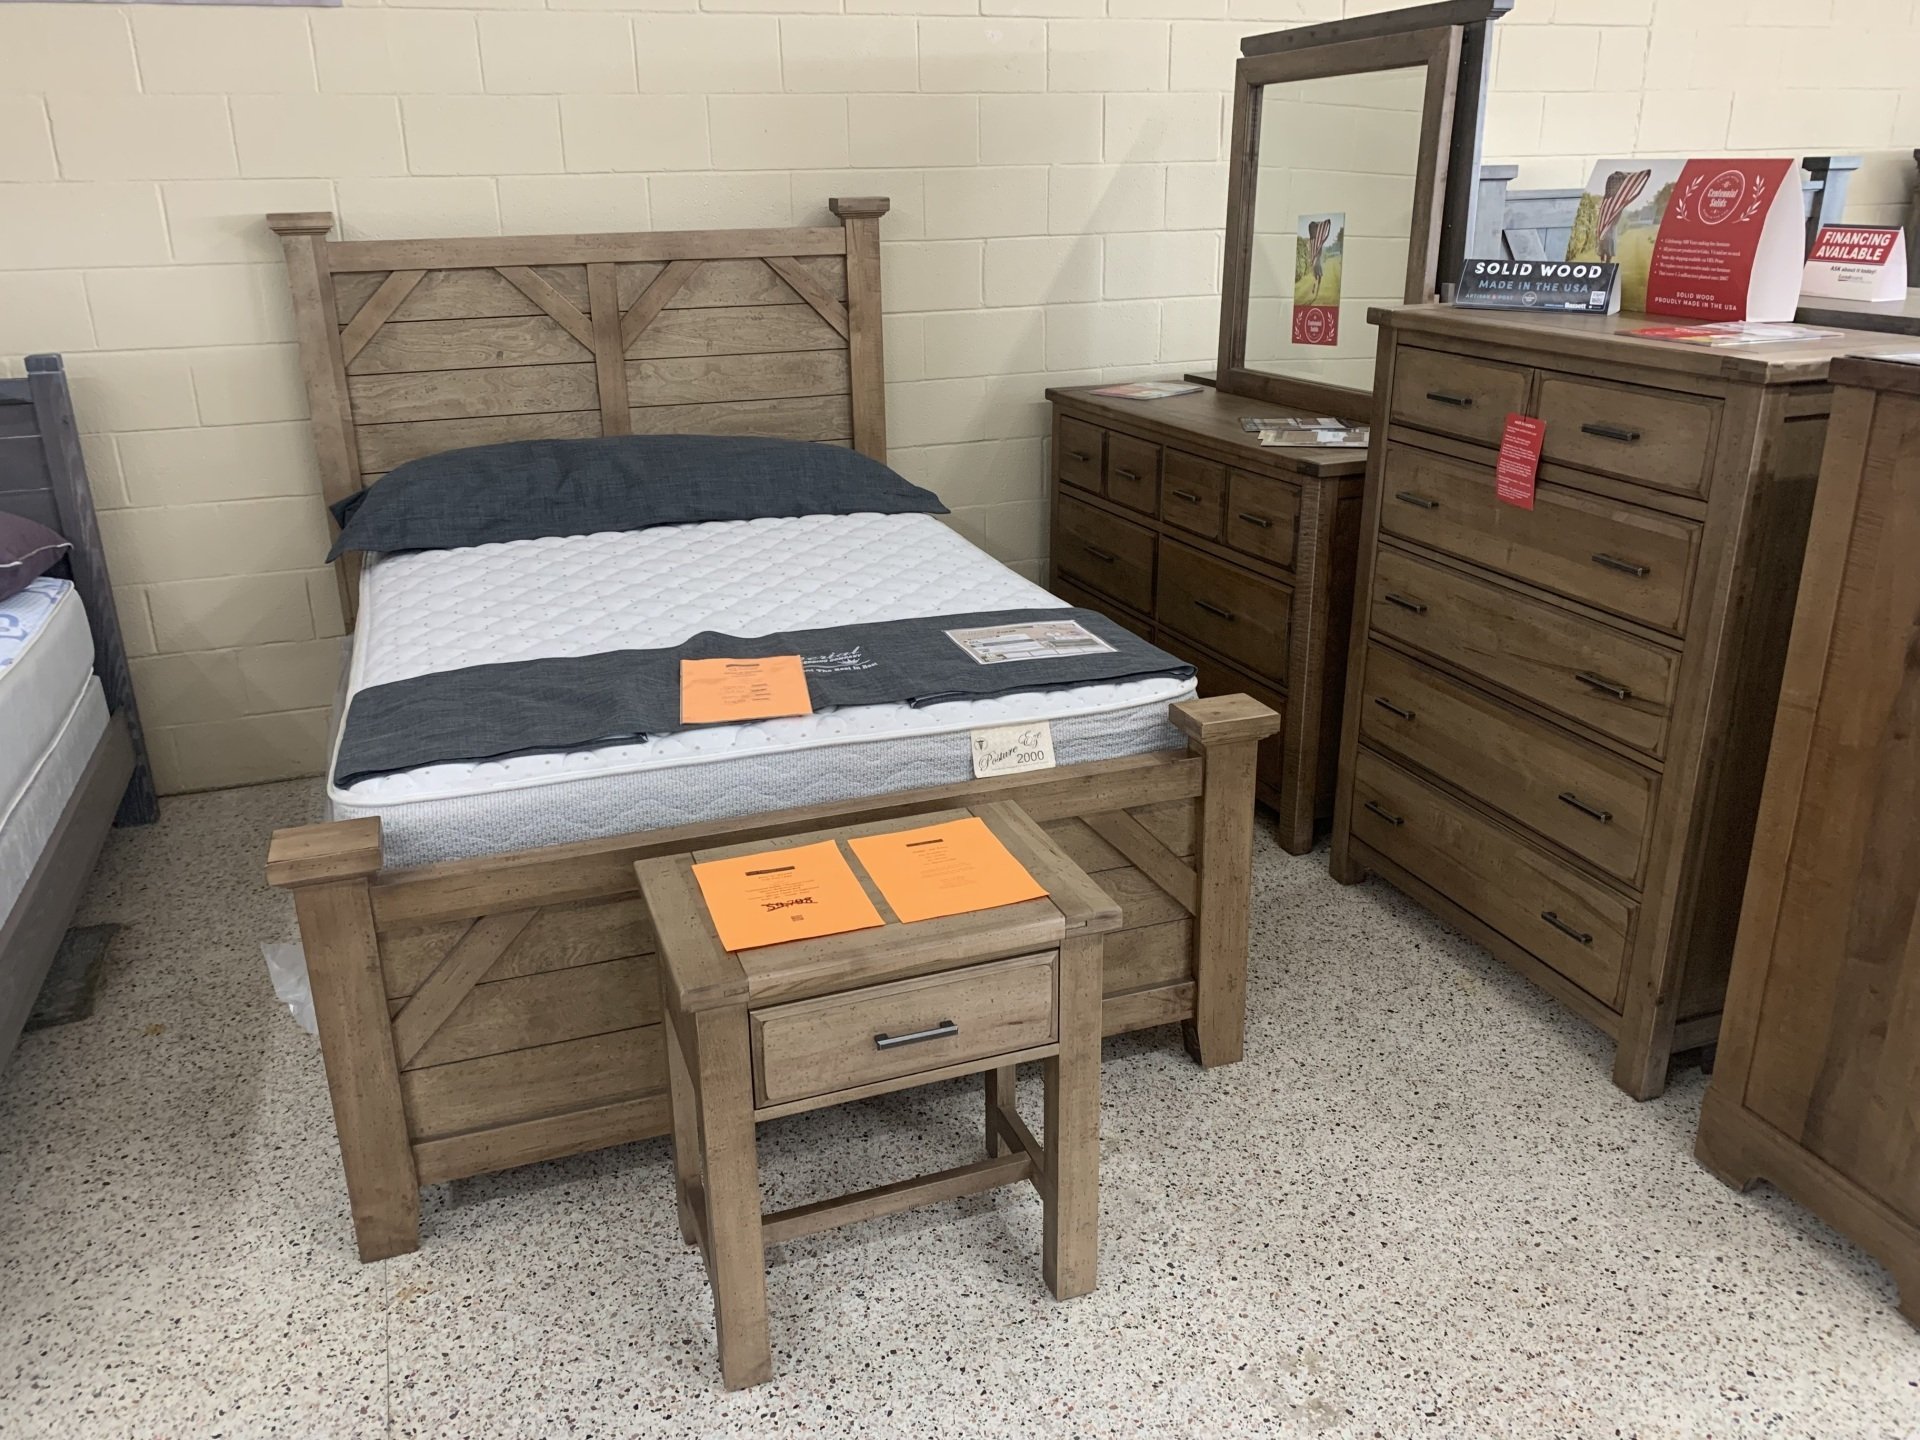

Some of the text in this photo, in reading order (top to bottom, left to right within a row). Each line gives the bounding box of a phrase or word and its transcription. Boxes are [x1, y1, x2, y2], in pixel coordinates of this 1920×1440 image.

[1822, 231, 1892, 247] FINANCING
[1816, 245, 1884, 261] AVAILABLE
[1474, 262, 1602, 279] SOLID WOOD
[1478, 280, 1589, 293] MADE IN THE USA
[1654, 296, 1681, 305] PROUDLY
[1683, 299, 1700, 307] MADE
[1710, 302, 1722, 310] THE
[1676, 291, 1715, 301] SOLID WOOD
[1016, 750, 1045, 764] 2000
